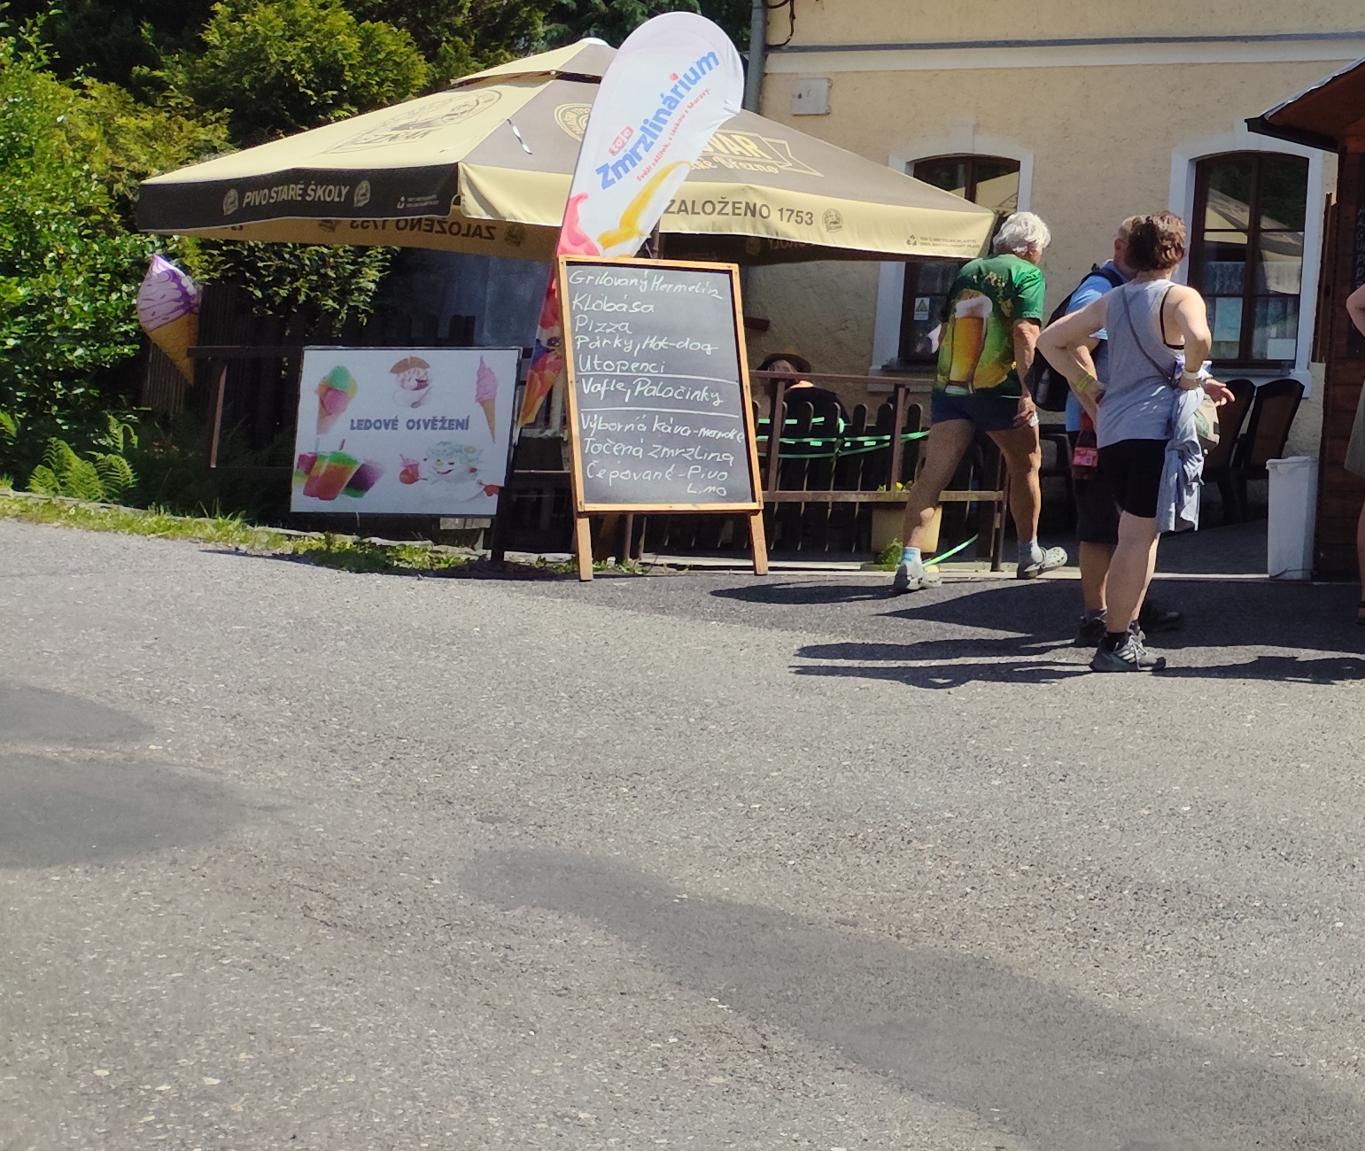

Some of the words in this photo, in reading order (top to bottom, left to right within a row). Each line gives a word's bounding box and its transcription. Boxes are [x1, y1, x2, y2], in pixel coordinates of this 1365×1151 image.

[596, 50, 720, 189] Zmrzlinárium
[242, 188, 269, 208] PIVO
[270, 181, 303, 203] STARÉ
[305, 180, 350, 202] ŠKOLY
[665, 196, 771, 219] ZALOŽENO
[778, 207, 814, 226] 1753
[569, 270, 649, 293] Grilovaný
[650, 275, 723, 299] Hermelín
[574, 315, 632, 334] Pizza
[578, 354, 665, 374] Utopenci
[632, 377, 724, 406] Palačinky
[350, 415, 399, 430] LEDOVÉ
[406, 415, 470, 430] OSVĚŽENÍ
[580, 412, 646, 436] Výborná
[584, 438, 644, 458] Točená
[648, 445, 735, 466] zmrzlina
[687, 483, 727, 496] Limo
